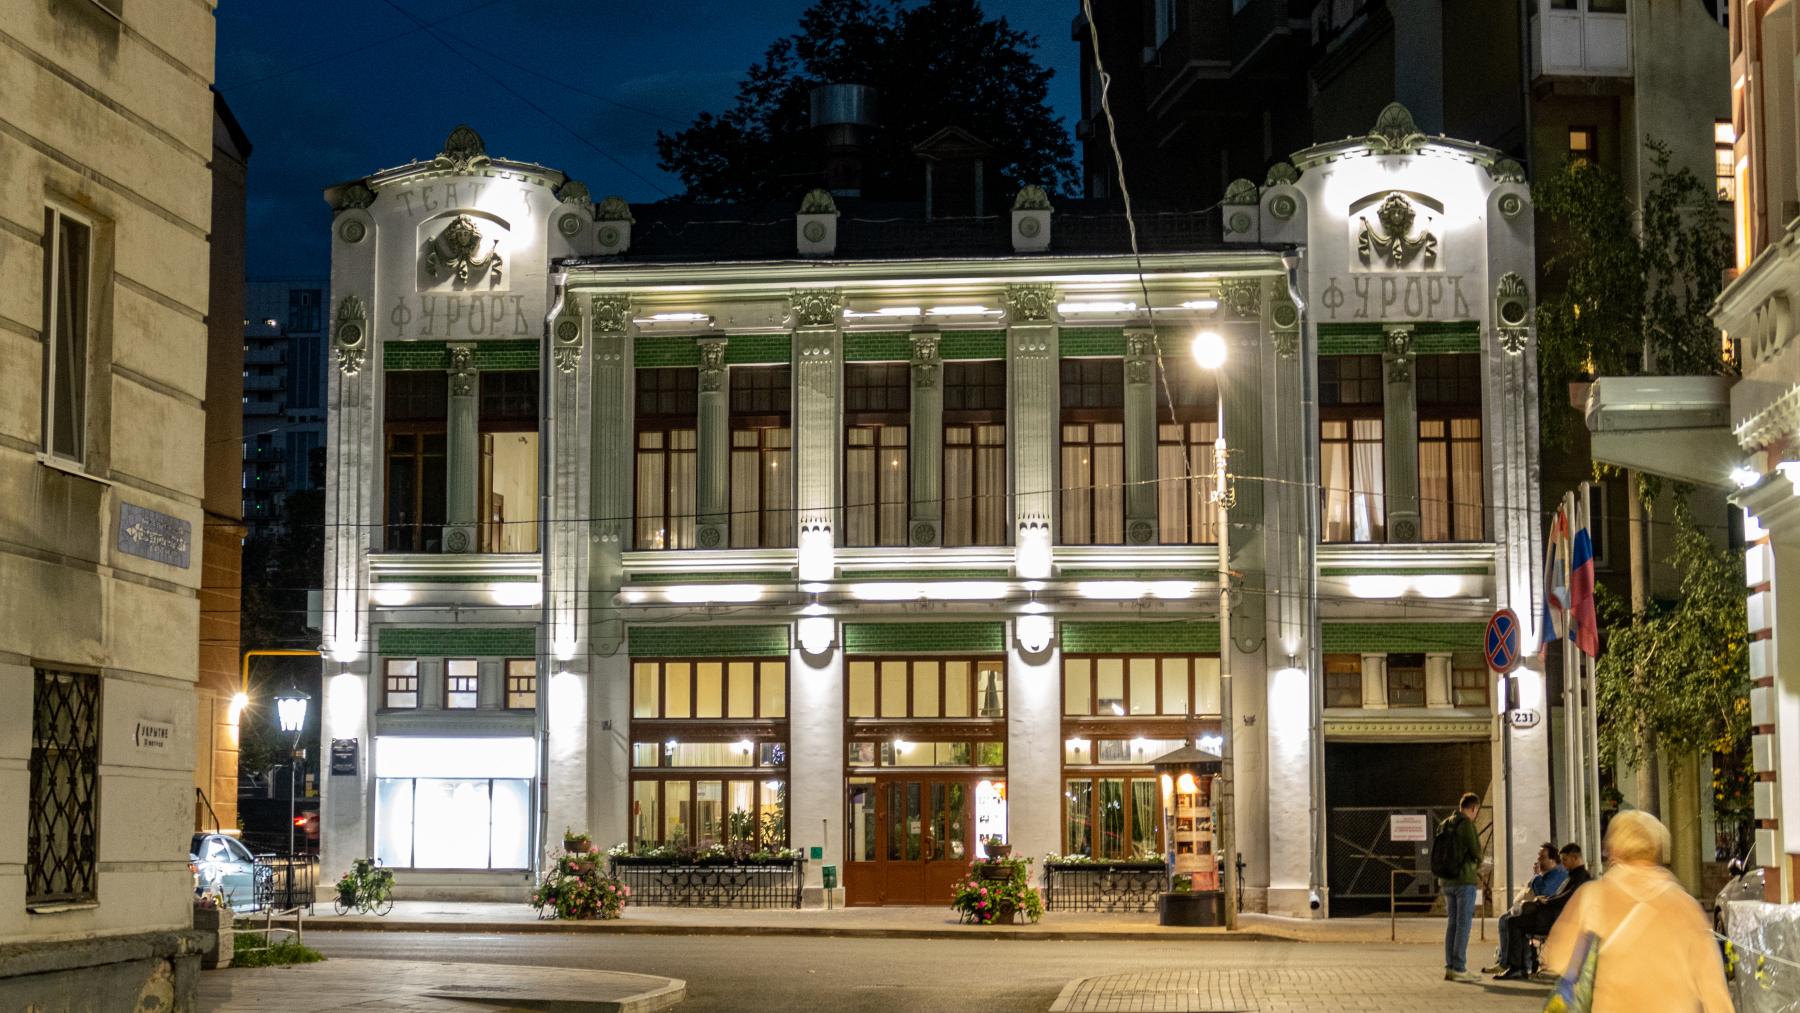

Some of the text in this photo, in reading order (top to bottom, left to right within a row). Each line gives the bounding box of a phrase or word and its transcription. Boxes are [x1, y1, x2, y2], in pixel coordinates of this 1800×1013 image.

[396, 182, 534, 217] ТЕАТЪ
[1321, 274, 1471, 319] ФУРОРЪ
[390, 294, 529, 337] ФУРОРЪ
[141, 726, 168, 738] УКРЫТИЕ
[1515, 713, 1533, 723] 231
